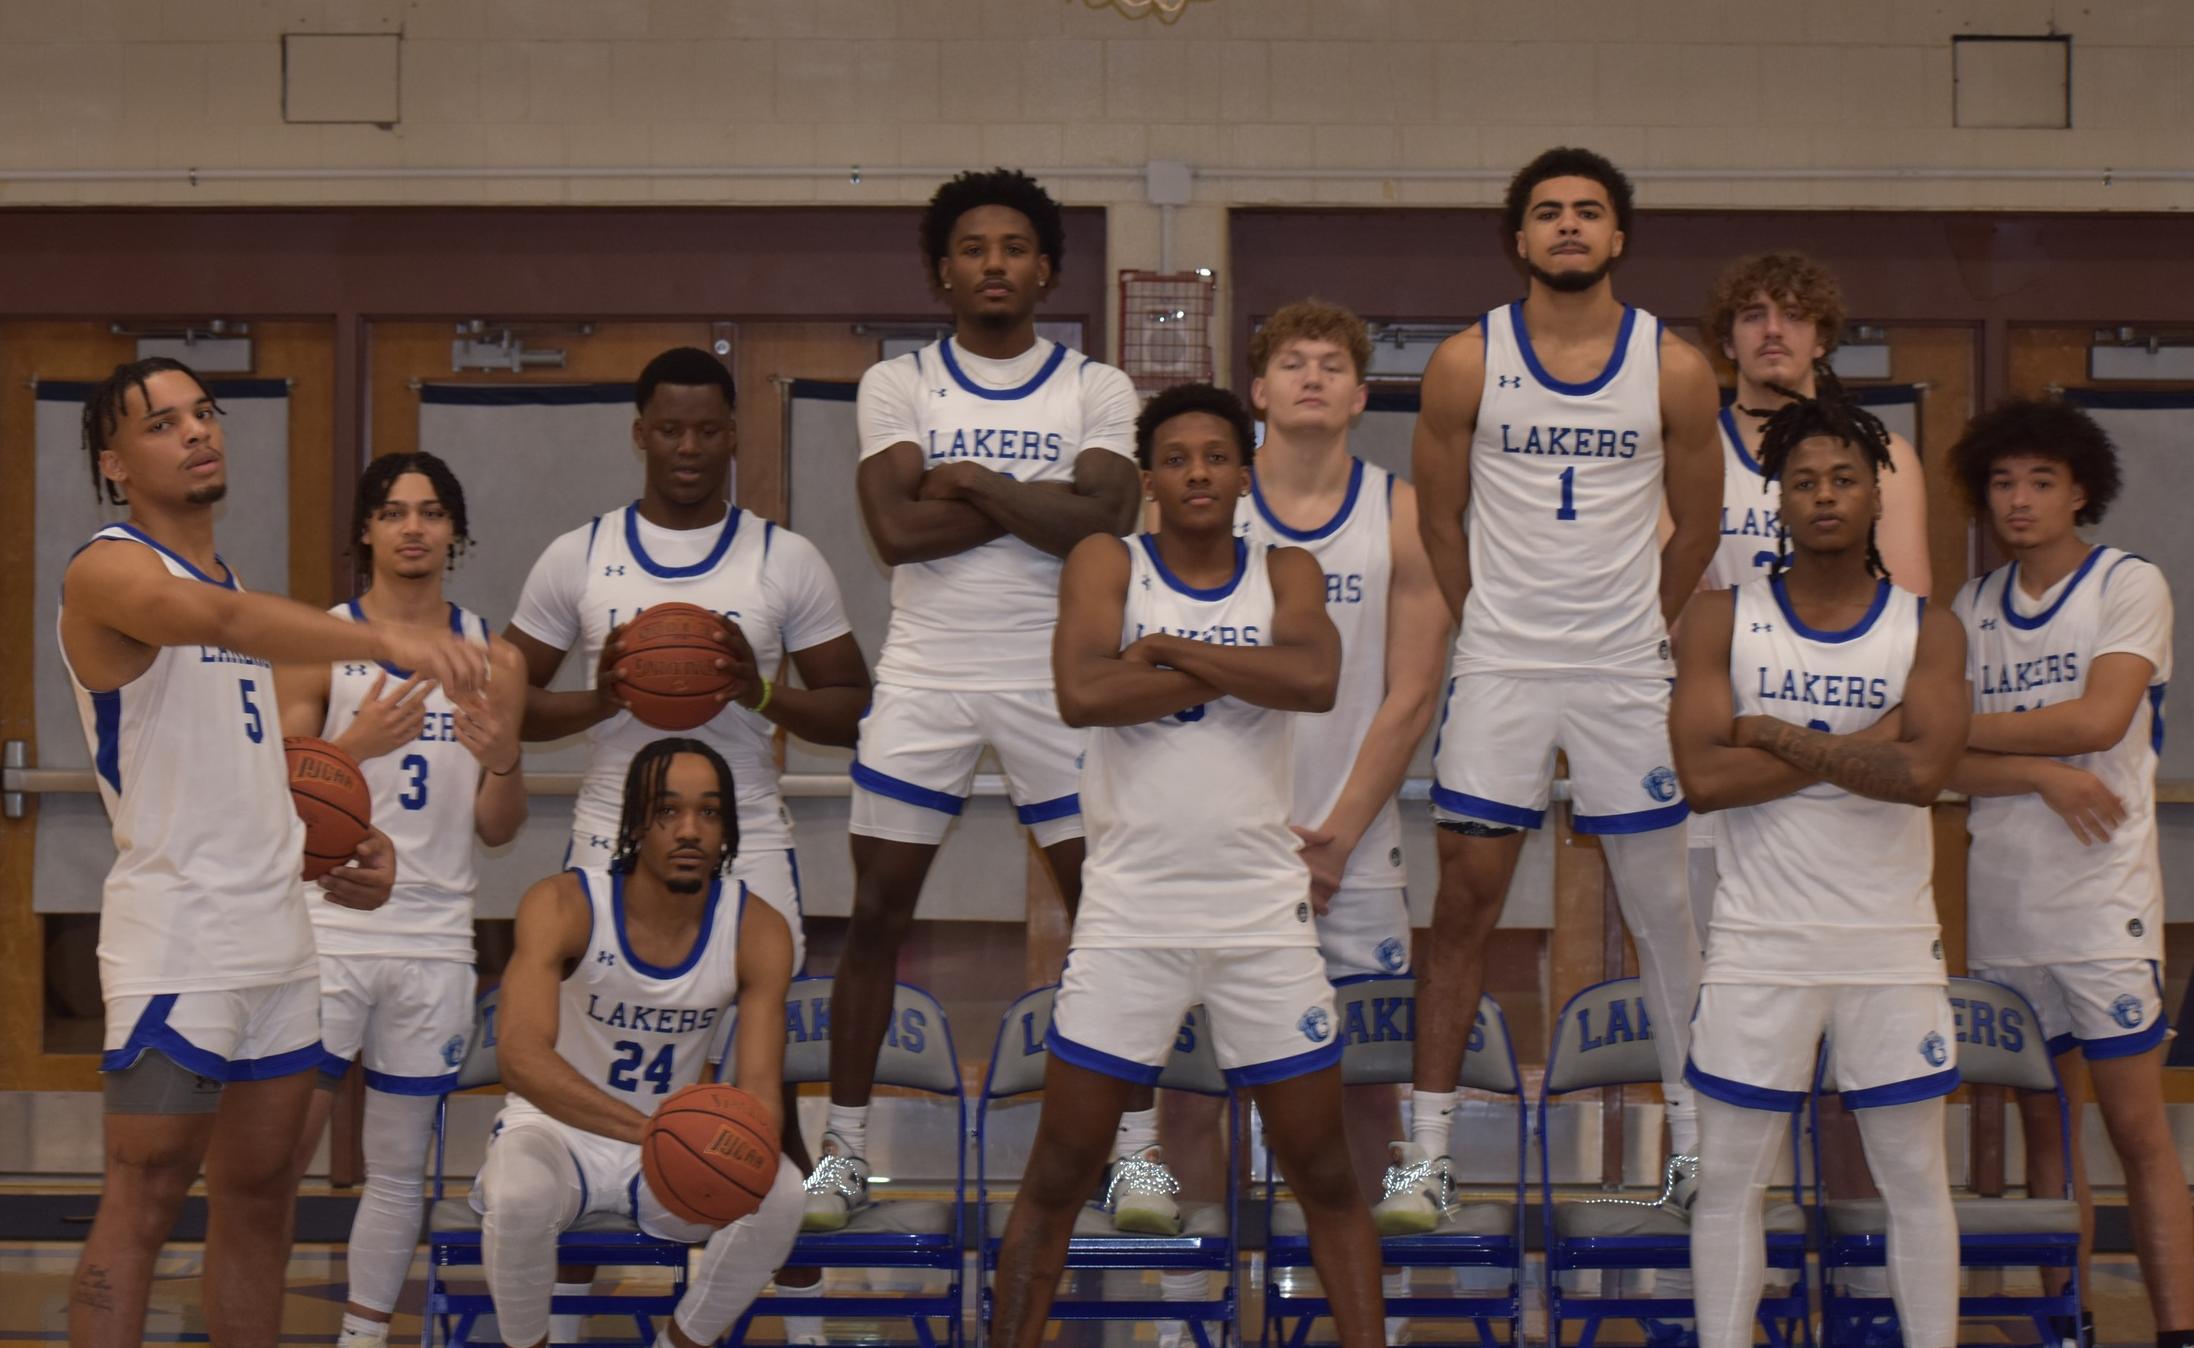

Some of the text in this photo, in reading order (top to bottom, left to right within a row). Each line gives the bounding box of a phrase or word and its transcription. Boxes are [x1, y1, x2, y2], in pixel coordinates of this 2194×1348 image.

[929, 428, 1063, 462] LAKERS
[1501, 424, 1640, 459] LAKERS
[1556, 466, 1577, 521] 1
[1758, 667, 1887, 709] LAKERS
[1982, 652, 2078, 694] LAKERS
[239, 678, 264, 744] 5
[399, 753, 429, 811] 3
[587, 993, 718, 1034] LAKERS
[607, 1040, 676, 1095] 24
